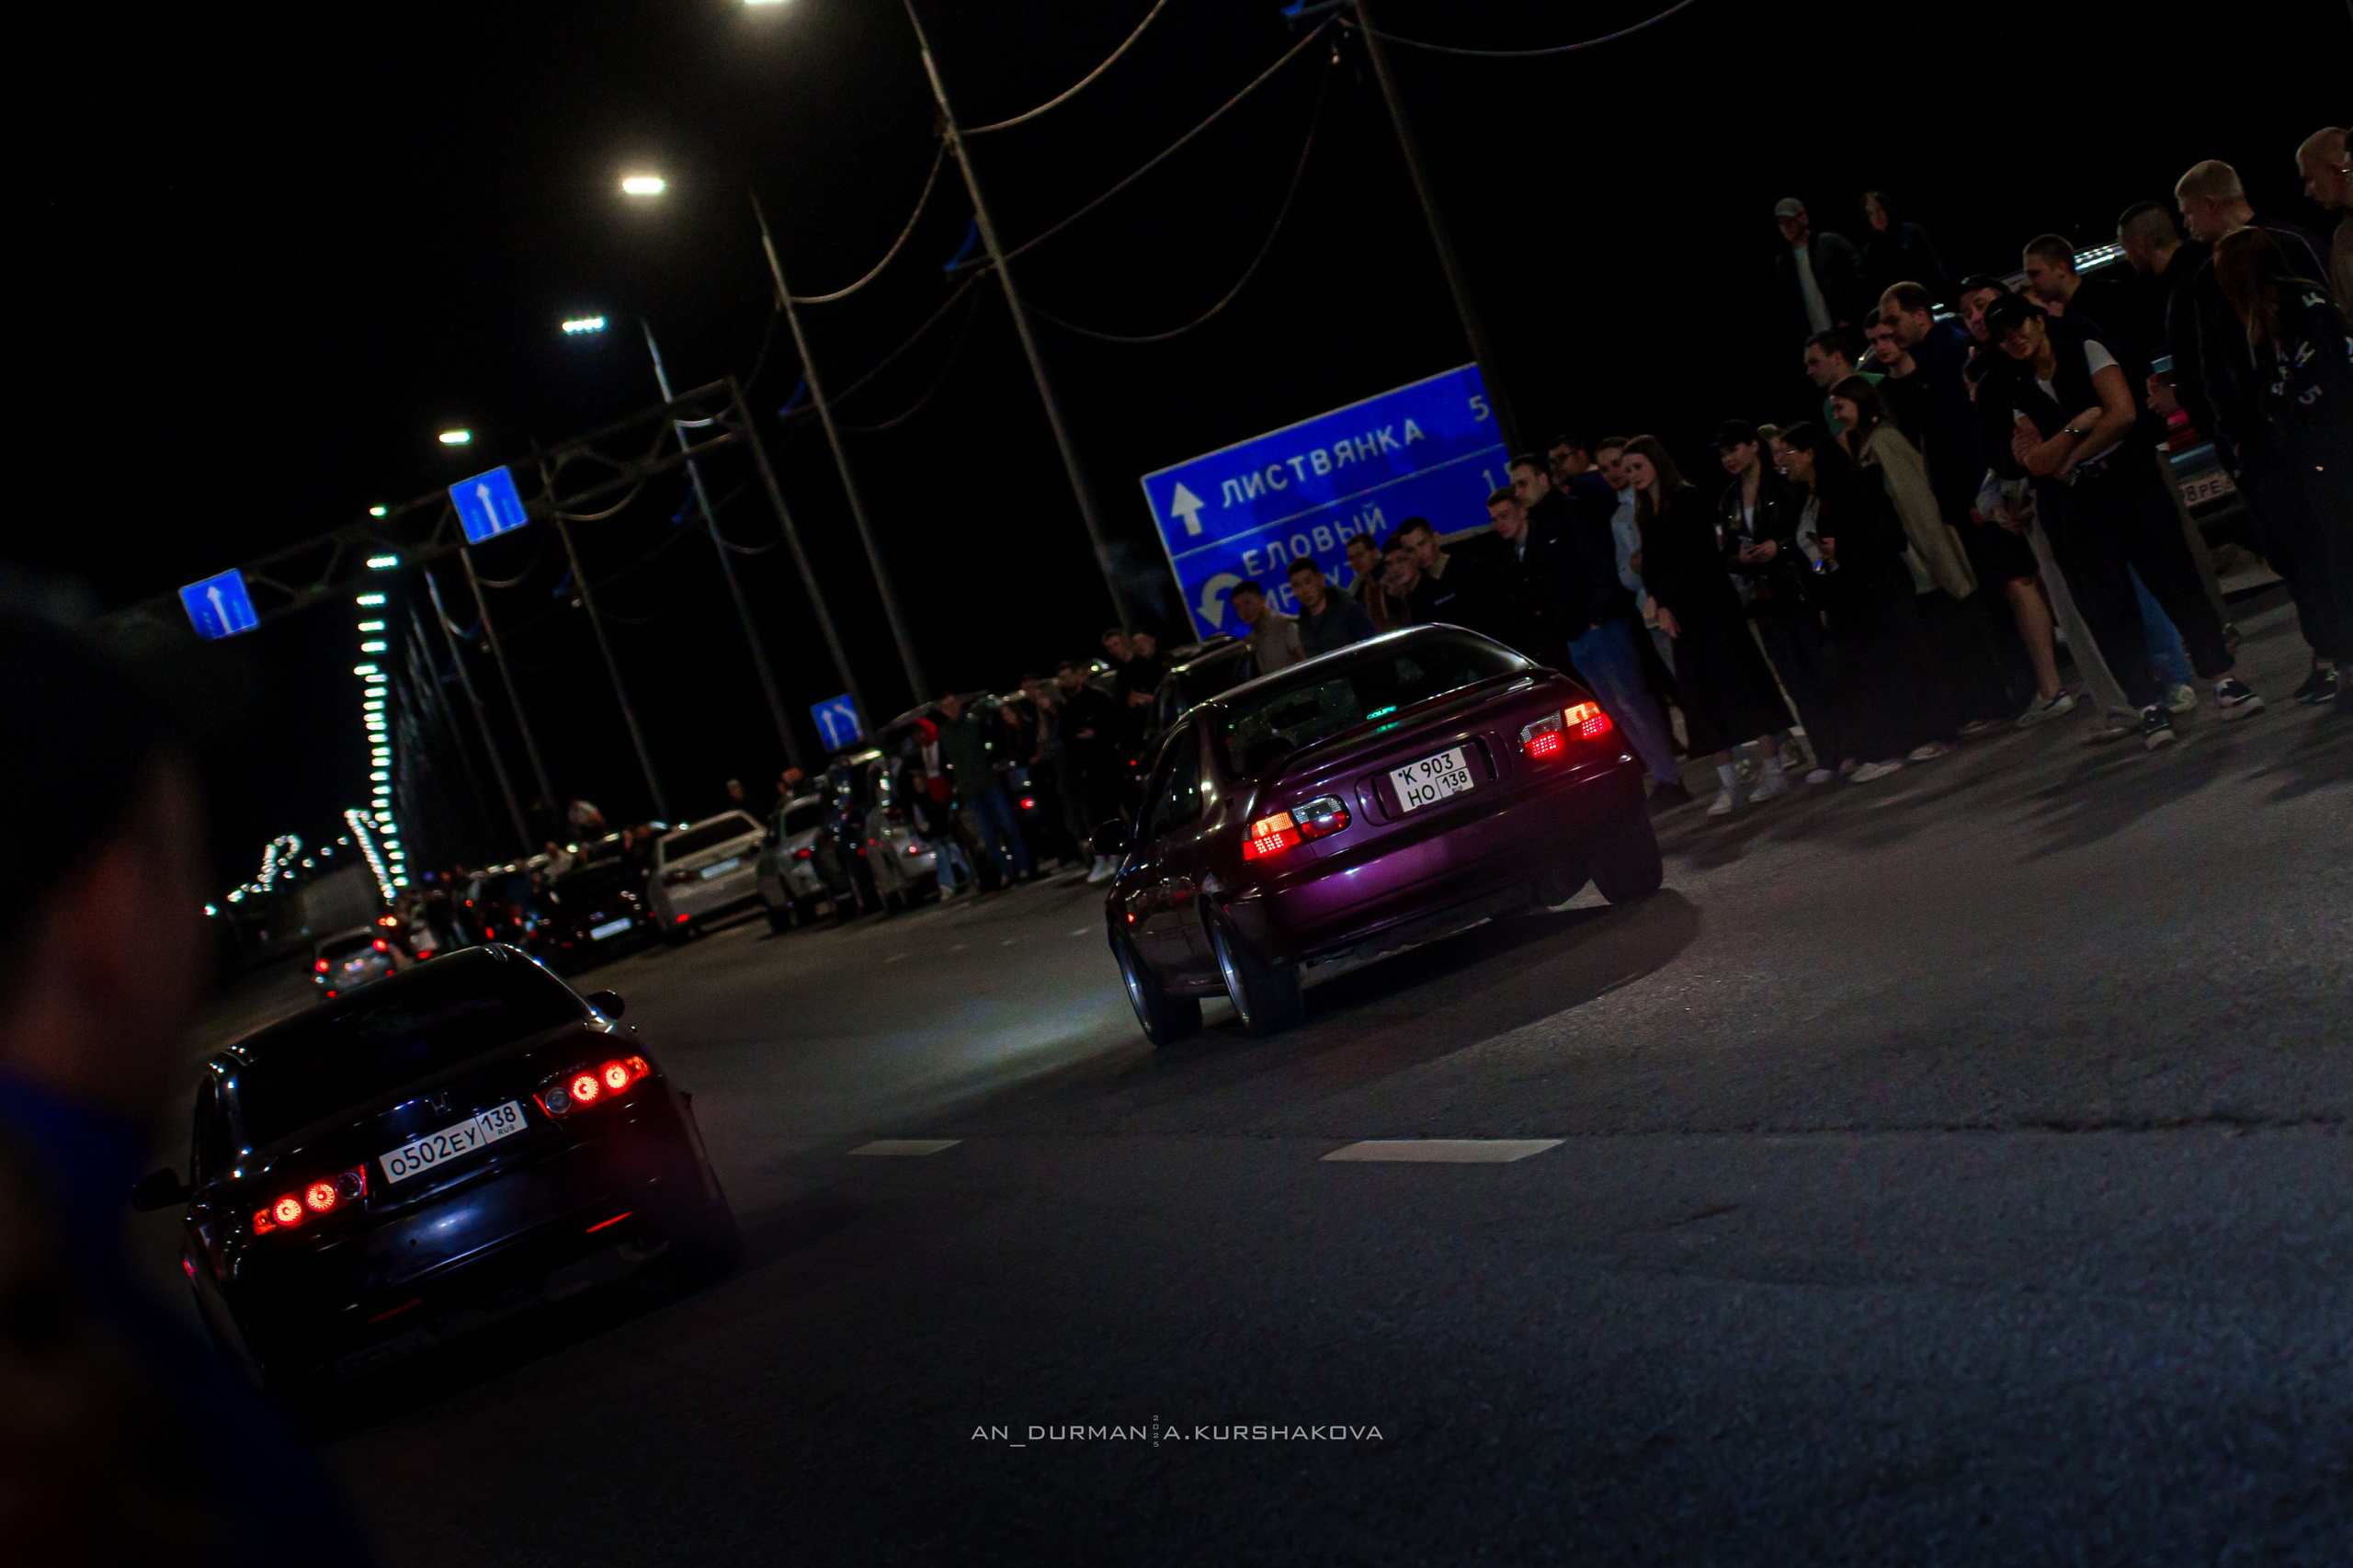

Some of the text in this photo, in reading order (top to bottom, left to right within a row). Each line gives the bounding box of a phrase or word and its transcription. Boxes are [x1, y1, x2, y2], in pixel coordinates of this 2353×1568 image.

[1222, 393, 1490, 509] ЛИСТВЯНКА 5
[1241, 501, 1389, 578] ЕЛОВЫЙ
[1420, 753, 1454, 778] 903
[1441, 770, 1468, 789] 138
[481, 1106, 517, 1131] 138
[497, 1123, 516, 1136] RUS
